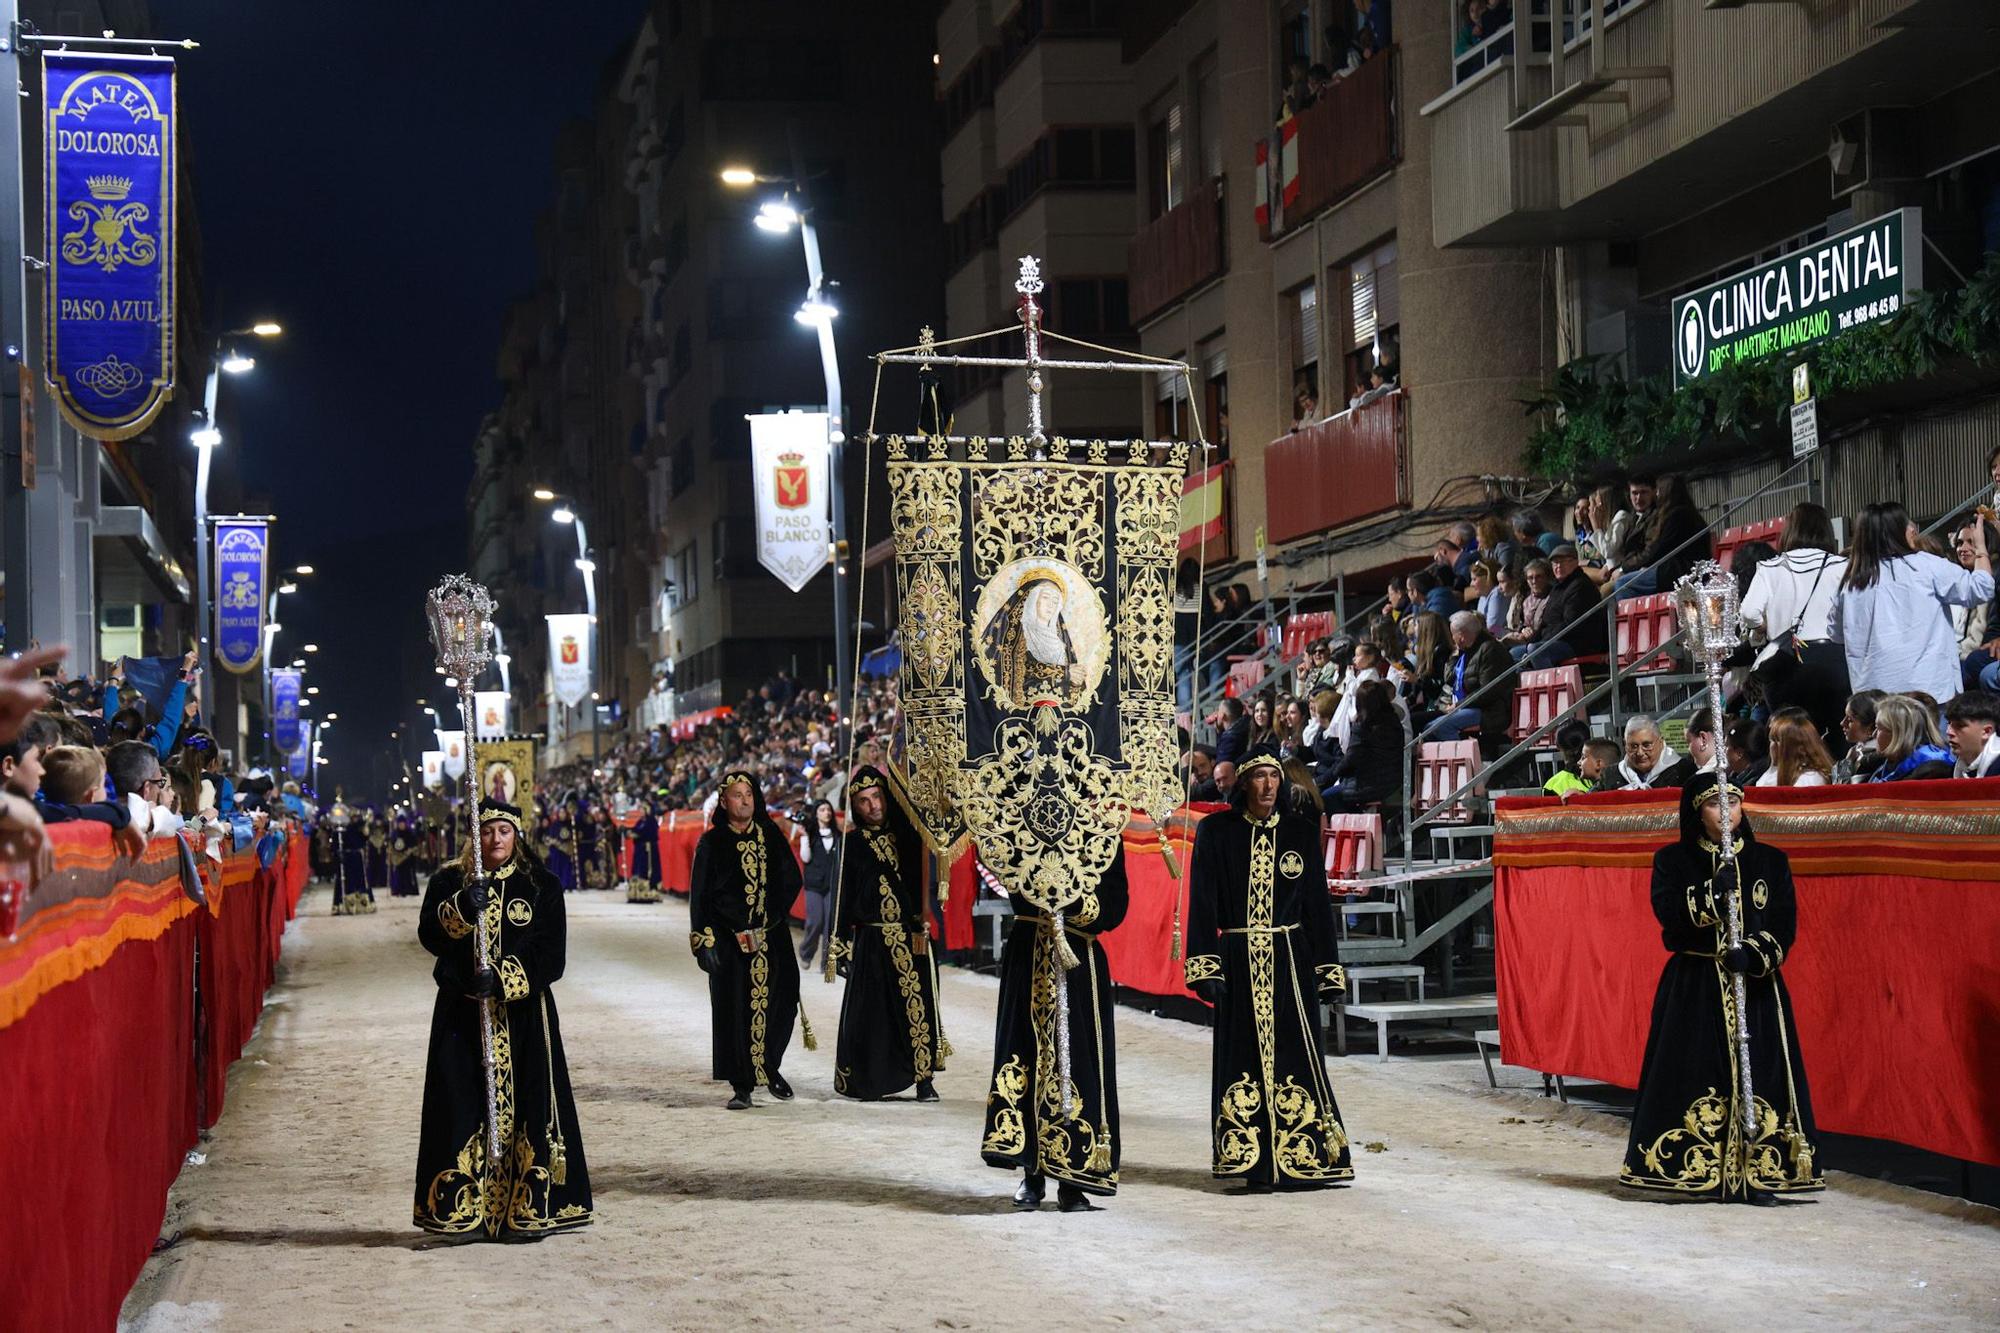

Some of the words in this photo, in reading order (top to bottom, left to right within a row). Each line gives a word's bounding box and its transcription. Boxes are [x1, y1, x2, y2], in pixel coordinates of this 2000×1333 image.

[67, 84, 151, 125] MATER
[58, 129, 160, 156] DOLOROSA
[1708, 265, 1794, 340] CLINICA
[1800, 225, 1899, 309] DENTAL
[61, 299, 105, 321] PASO
[109, 300, 158, 322] AZUL
[1854, 304, 1868, 325] 968
[1868, 301, 1878, 320] 46
[1878, 297, 1889, 316] 45
[1889, 294, 1899, 313] 80
[1780, 309, 1831, 349] MANZANO
[766, 528, 821, 543] BLANCO
[775, 515, 810, 528] PASO
